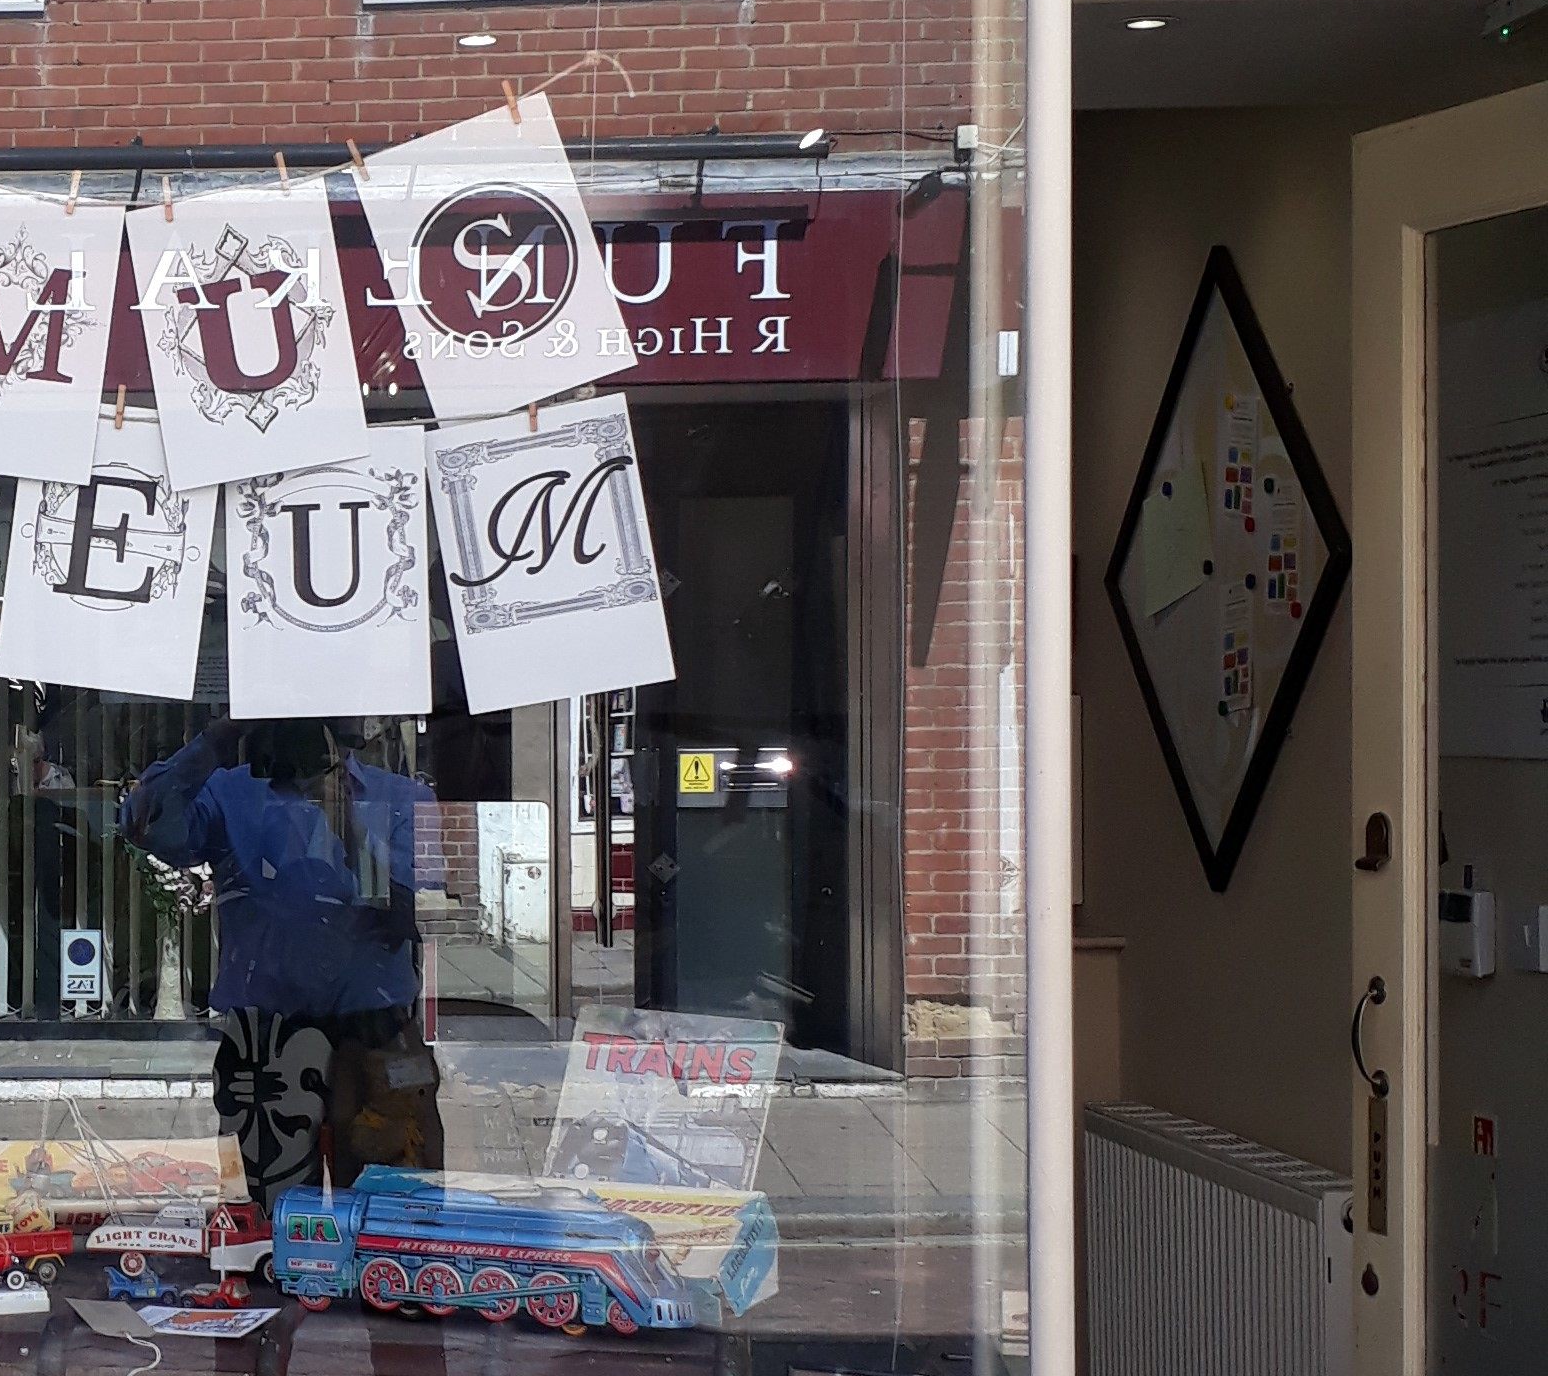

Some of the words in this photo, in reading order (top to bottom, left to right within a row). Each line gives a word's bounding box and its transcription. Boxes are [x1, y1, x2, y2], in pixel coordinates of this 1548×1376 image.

[452, 212, 533, 319] S
[176, 269, 299, 394] U
[52, 474, 158, 604] E
[281, 500, 372, 608] U
[449, 455, 634, 588] M
[583, 1030, 757, 1084] TRAINS
[14, 1209, 42, 1232] TOYS
[94, 1229, 145, 1245] LIGHT
[147, 1231, 199, 1248] CRANE
[399, 1240, 502, 1258] INTERNATIONAL
[505, 1249, 573, 1263] EXPRESS
